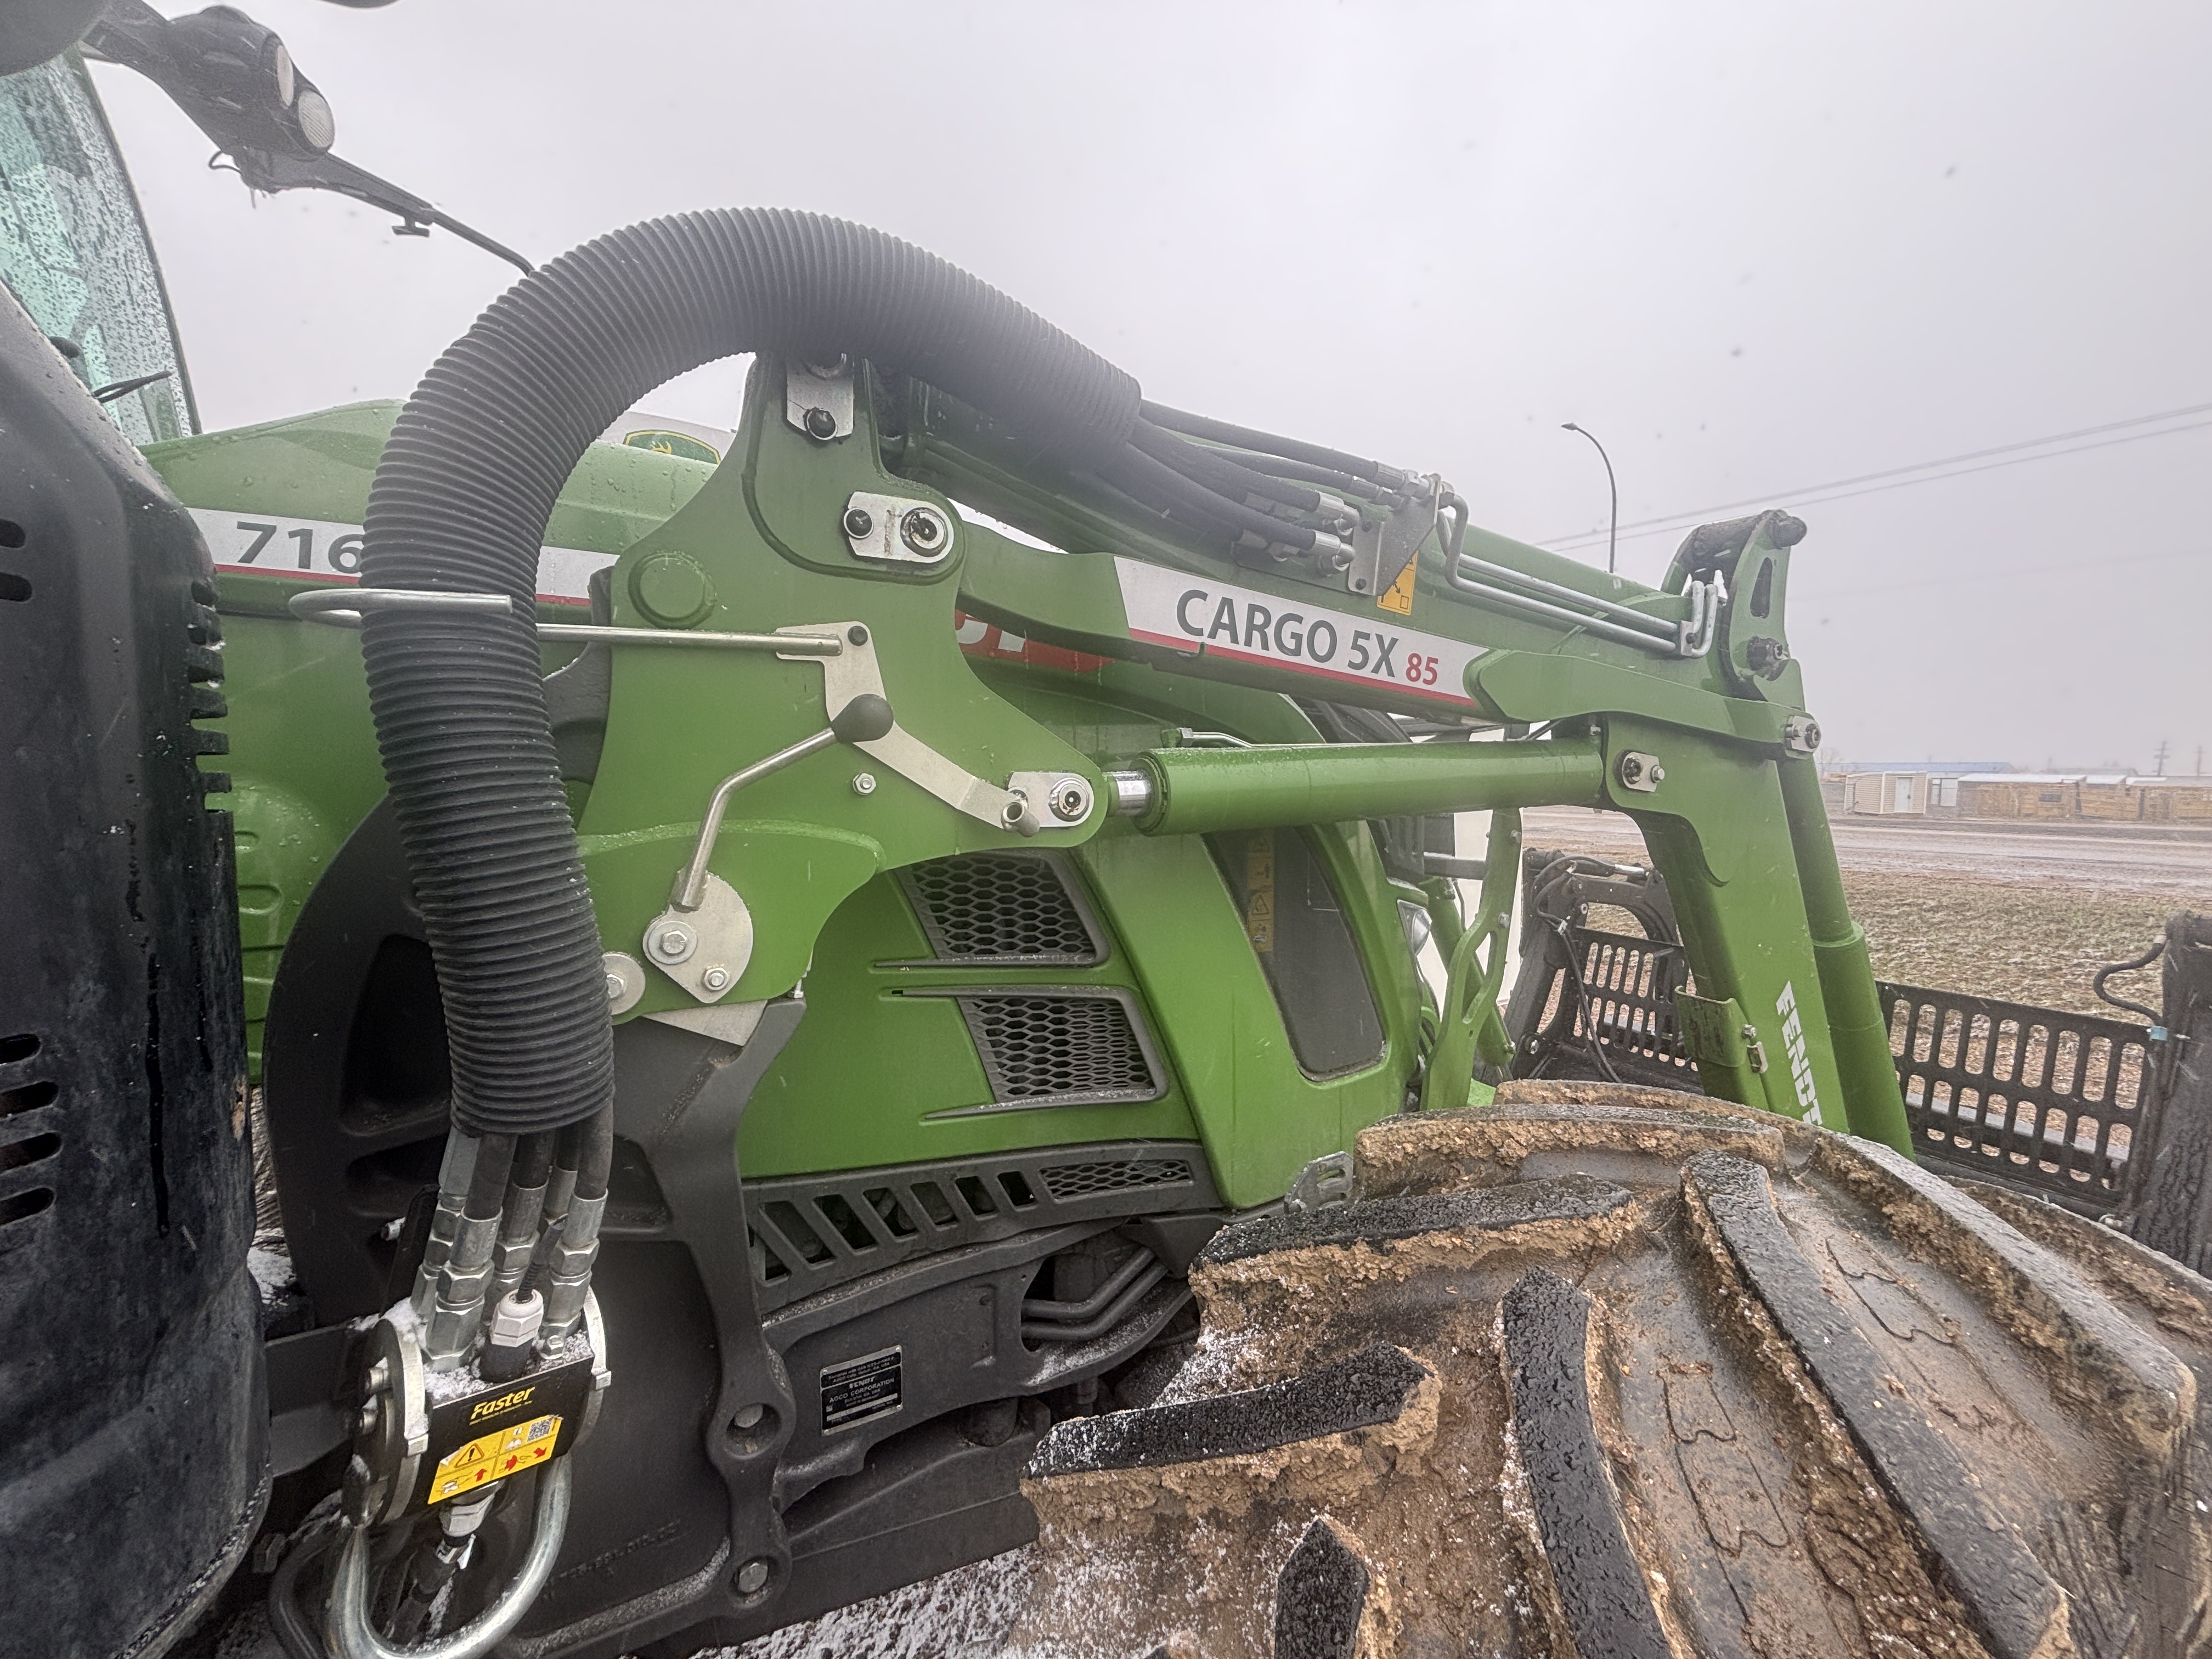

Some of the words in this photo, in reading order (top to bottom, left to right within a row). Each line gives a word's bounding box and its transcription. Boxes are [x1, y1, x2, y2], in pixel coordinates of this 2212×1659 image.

[236, 521, 364, 574] 716
[1176, 589, 1337, 663] CARGO
[1348, 629, 1400, 678] 5X
[1406, 652, 1439, 686] 85
[1776, 980, 1823, 1125] FENDT
[470, 1386, 535, 1420] Faster
[830, 1393, 848, 1403] AGCO
[850, 1378, 895, 1396] CORPORATION
[849, 1376, 876, 1389] FENDT
